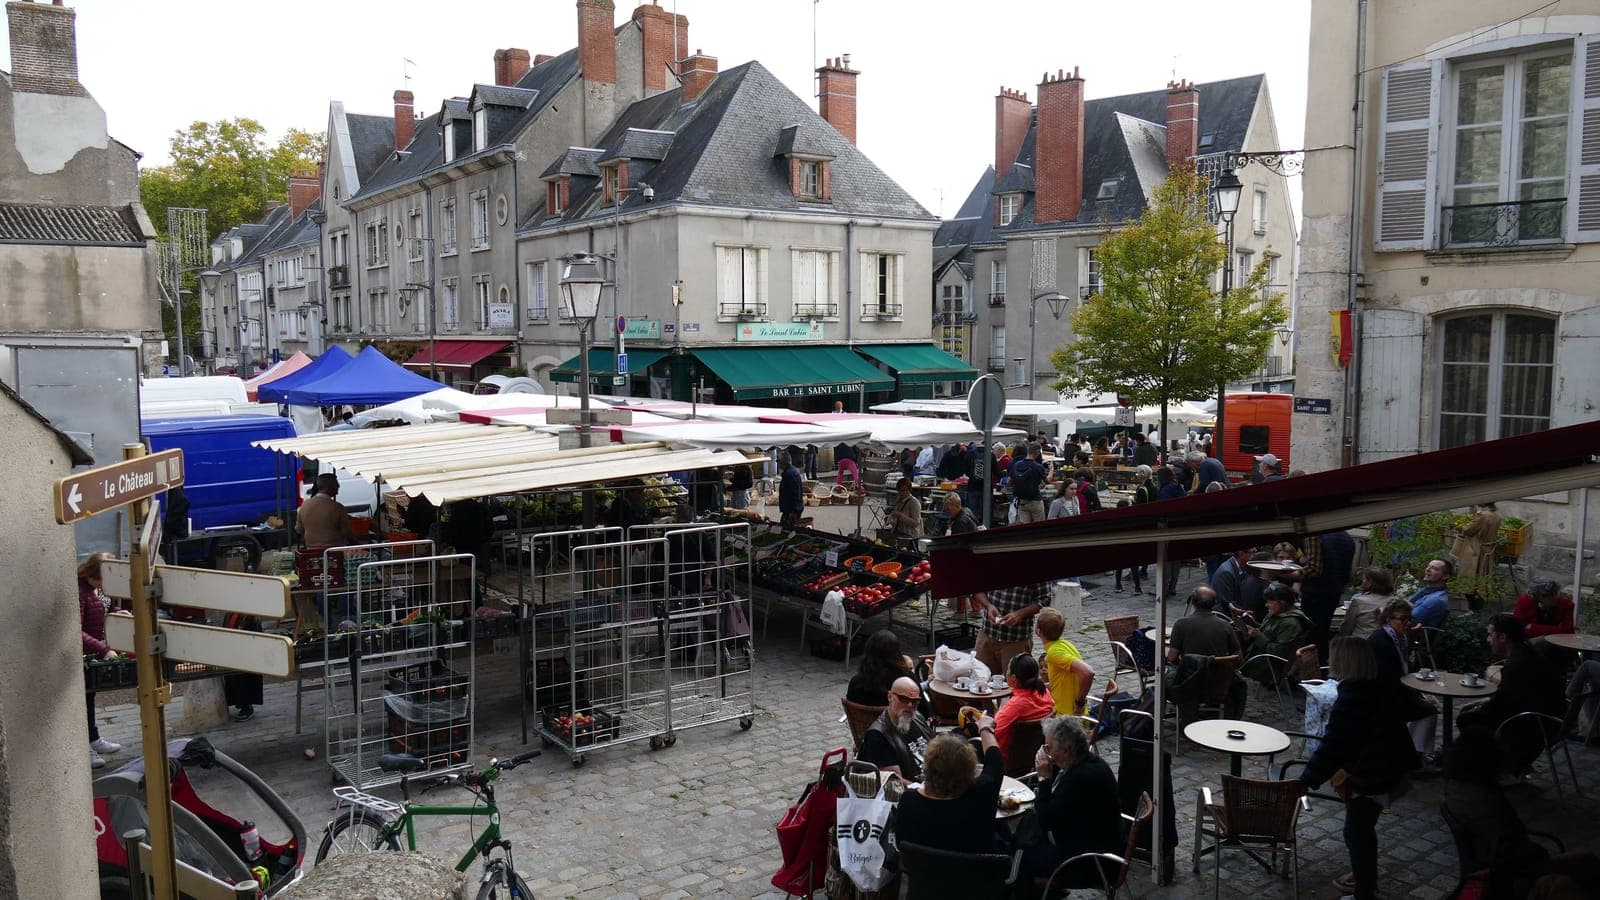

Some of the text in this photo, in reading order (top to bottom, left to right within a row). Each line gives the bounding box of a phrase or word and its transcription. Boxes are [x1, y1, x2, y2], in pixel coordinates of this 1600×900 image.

[769, 327, 787, 336] Saint
[773, 383, 861, 397] BAR LE SAINT LUBIN
[104, 471, 154, 499] Le Château
